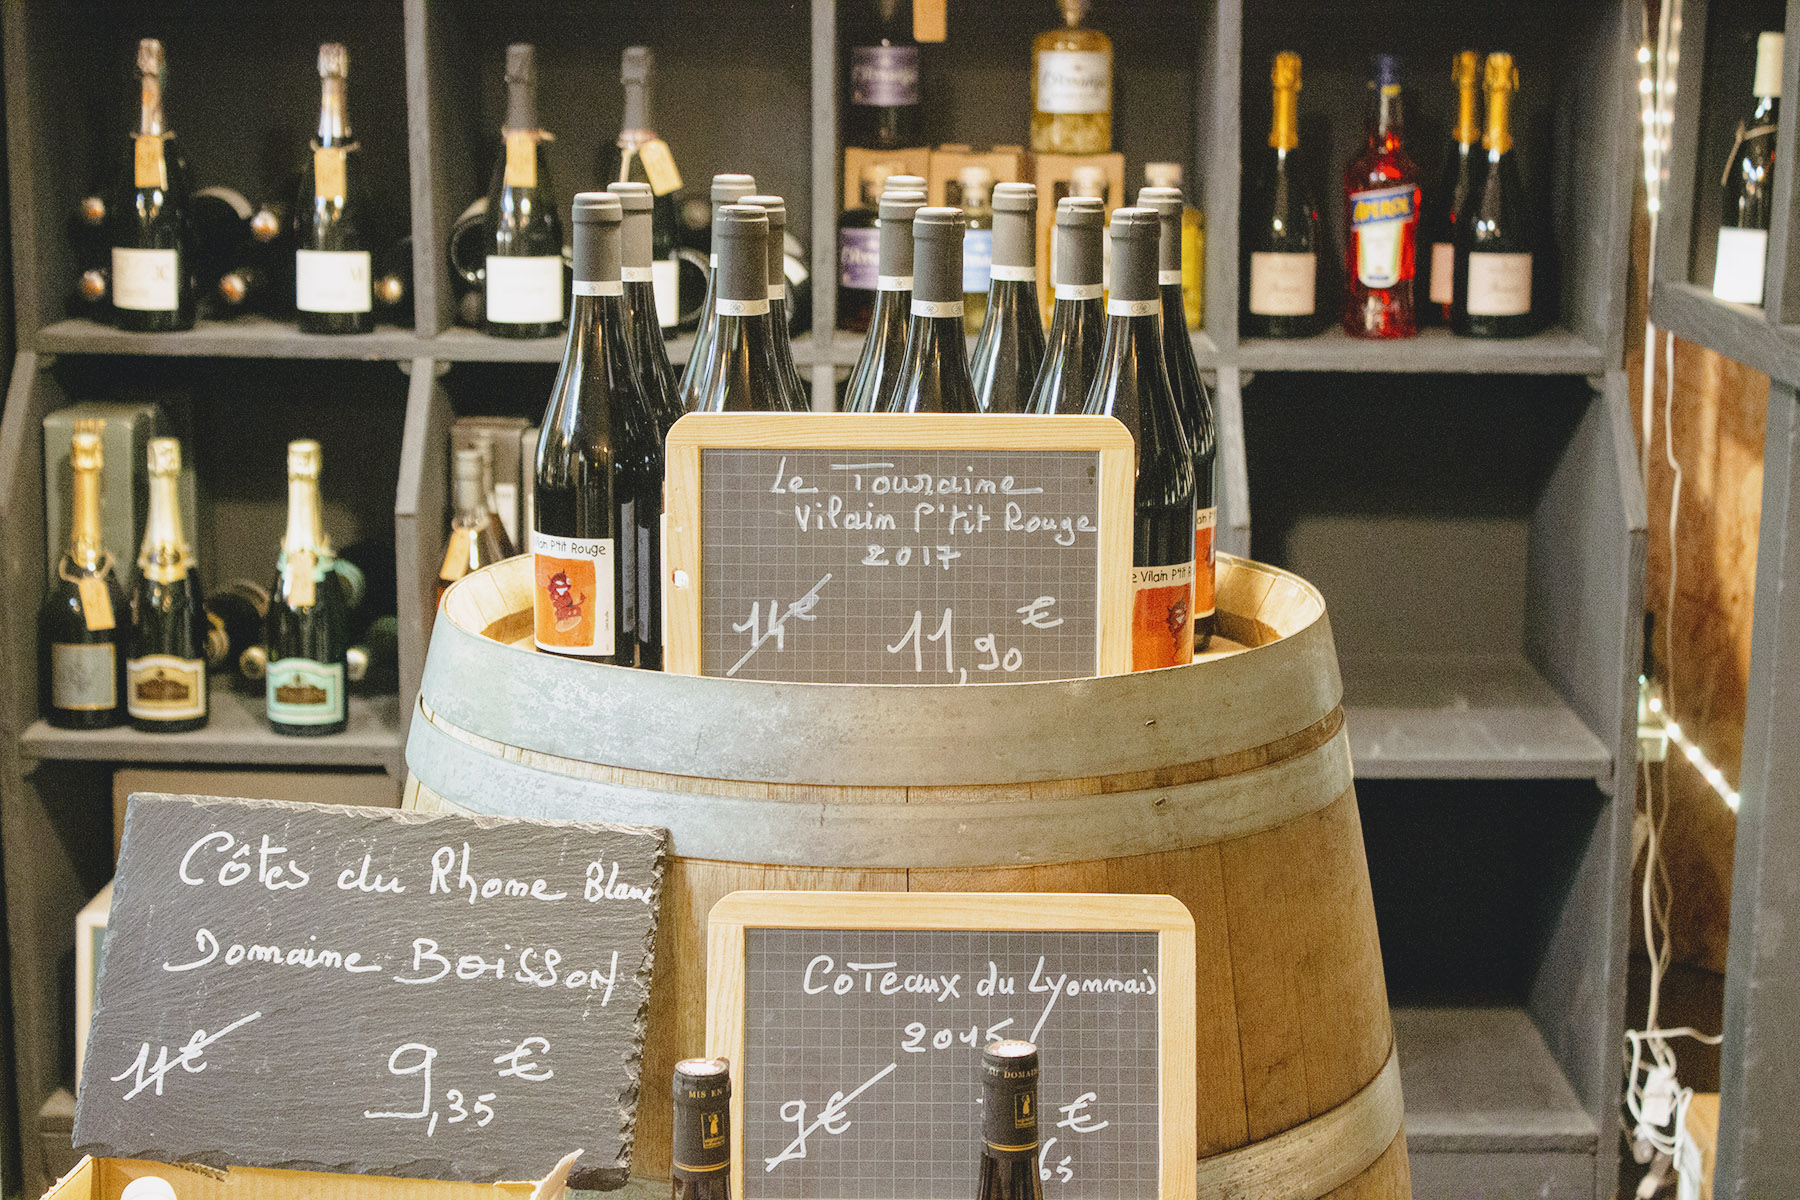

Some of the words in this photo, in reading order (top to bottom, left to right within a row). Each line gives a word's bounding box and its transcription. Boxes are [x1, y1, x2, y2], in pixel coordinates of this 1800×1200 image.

[770, 456, 819, 494] Le
[829, 462, 1044, 496] Touraine
[794, 495, 897, 533] Vilain
[1004, 500, 1098, 546] Rouge
[571, 542, 607, 558] Rouge
[860, 545, 962, 571] 2017
[1016, 596, 1064, 629] €
[178, 830, 310, 891] Côtes
[336, 853, 407, 894] du
[162, 927, 383, 973] Domaine
[975, 960, 1016, 998] du
[1027, 955, 1158, 1044] Lyonnais
[492, 1036, 555, 1082] €
[688, 1090, 707, 1099] MIS
[1055, 1091, 1109, 1134] €
